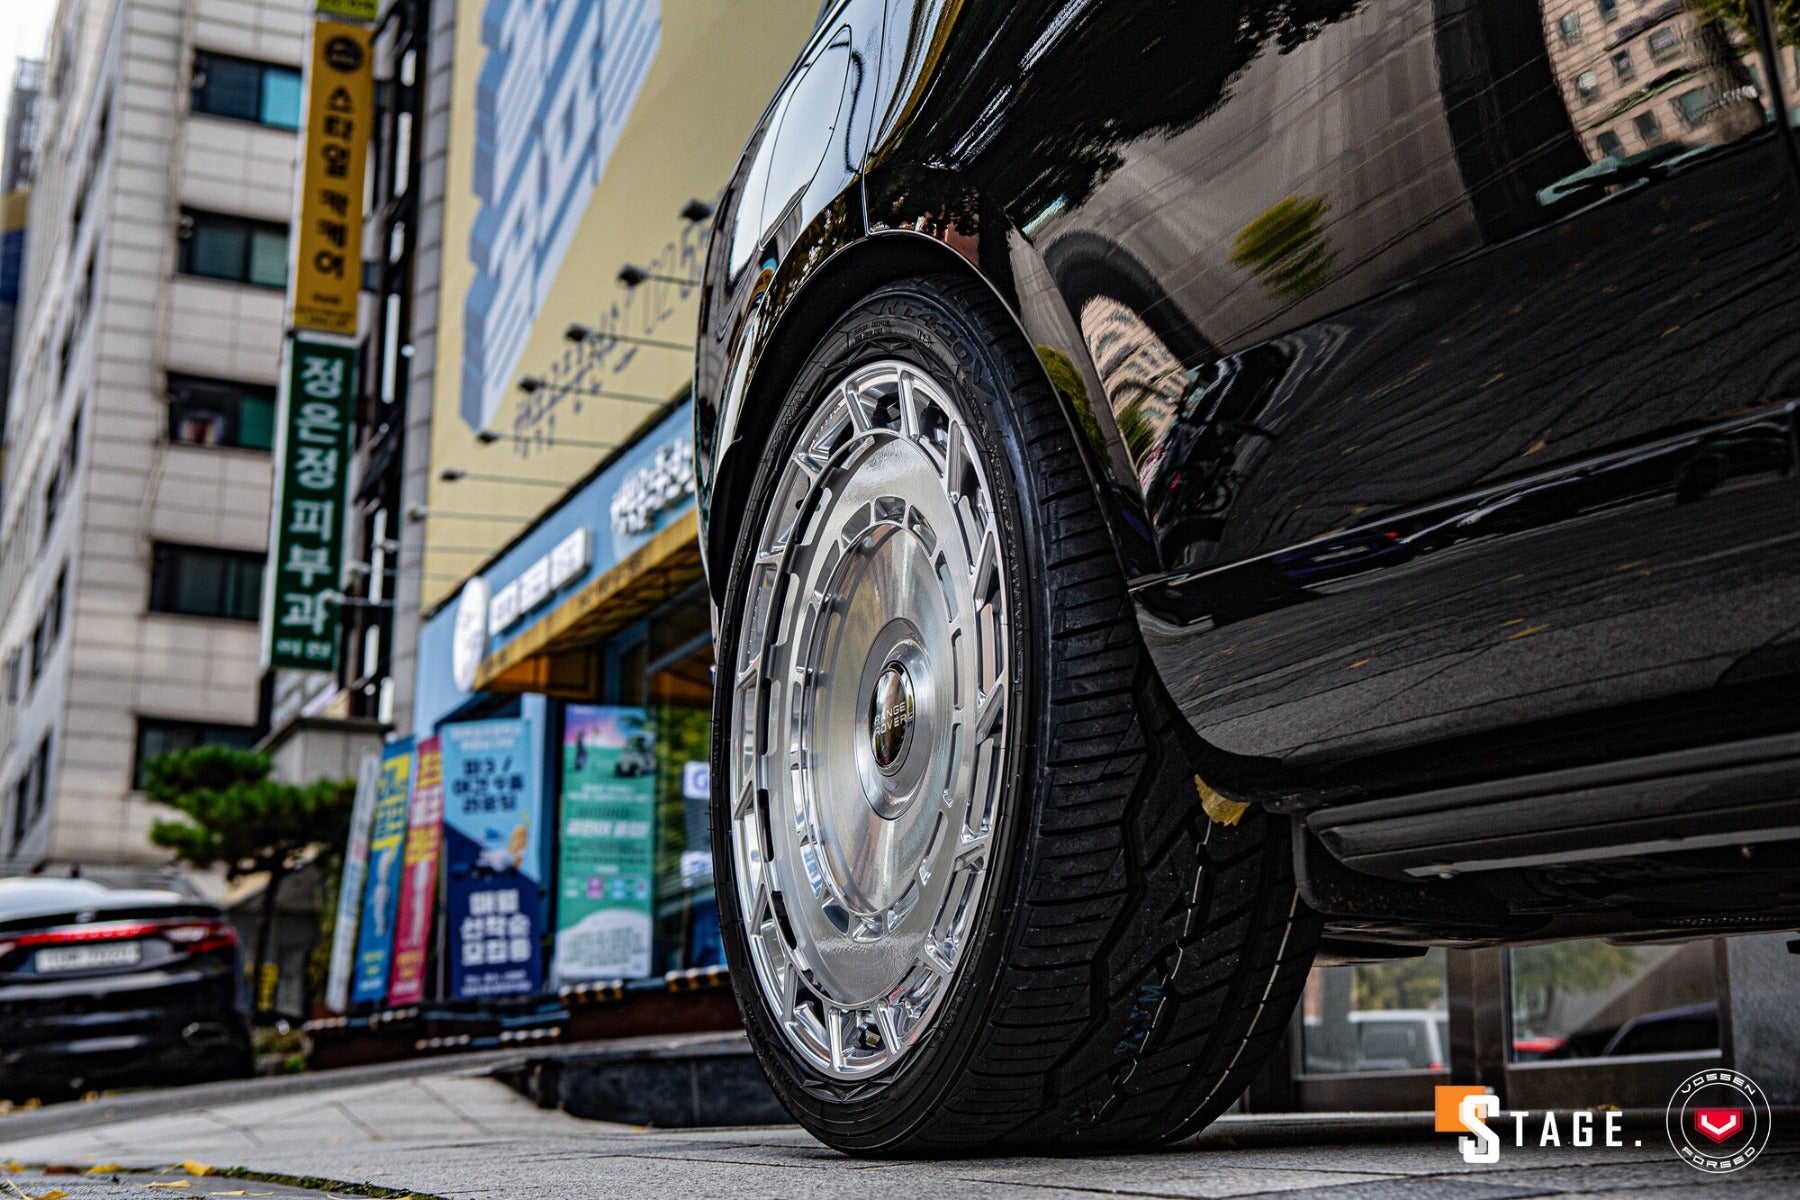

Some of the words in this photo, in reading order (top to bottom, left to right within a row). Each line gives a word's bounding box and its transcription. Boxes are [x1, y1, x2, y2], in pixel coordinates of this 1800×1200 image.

[281, 499, 334, 635] 피부과
[874, 701, 907, 727] RANGE
[874, 714, 910, 736] ROVER
